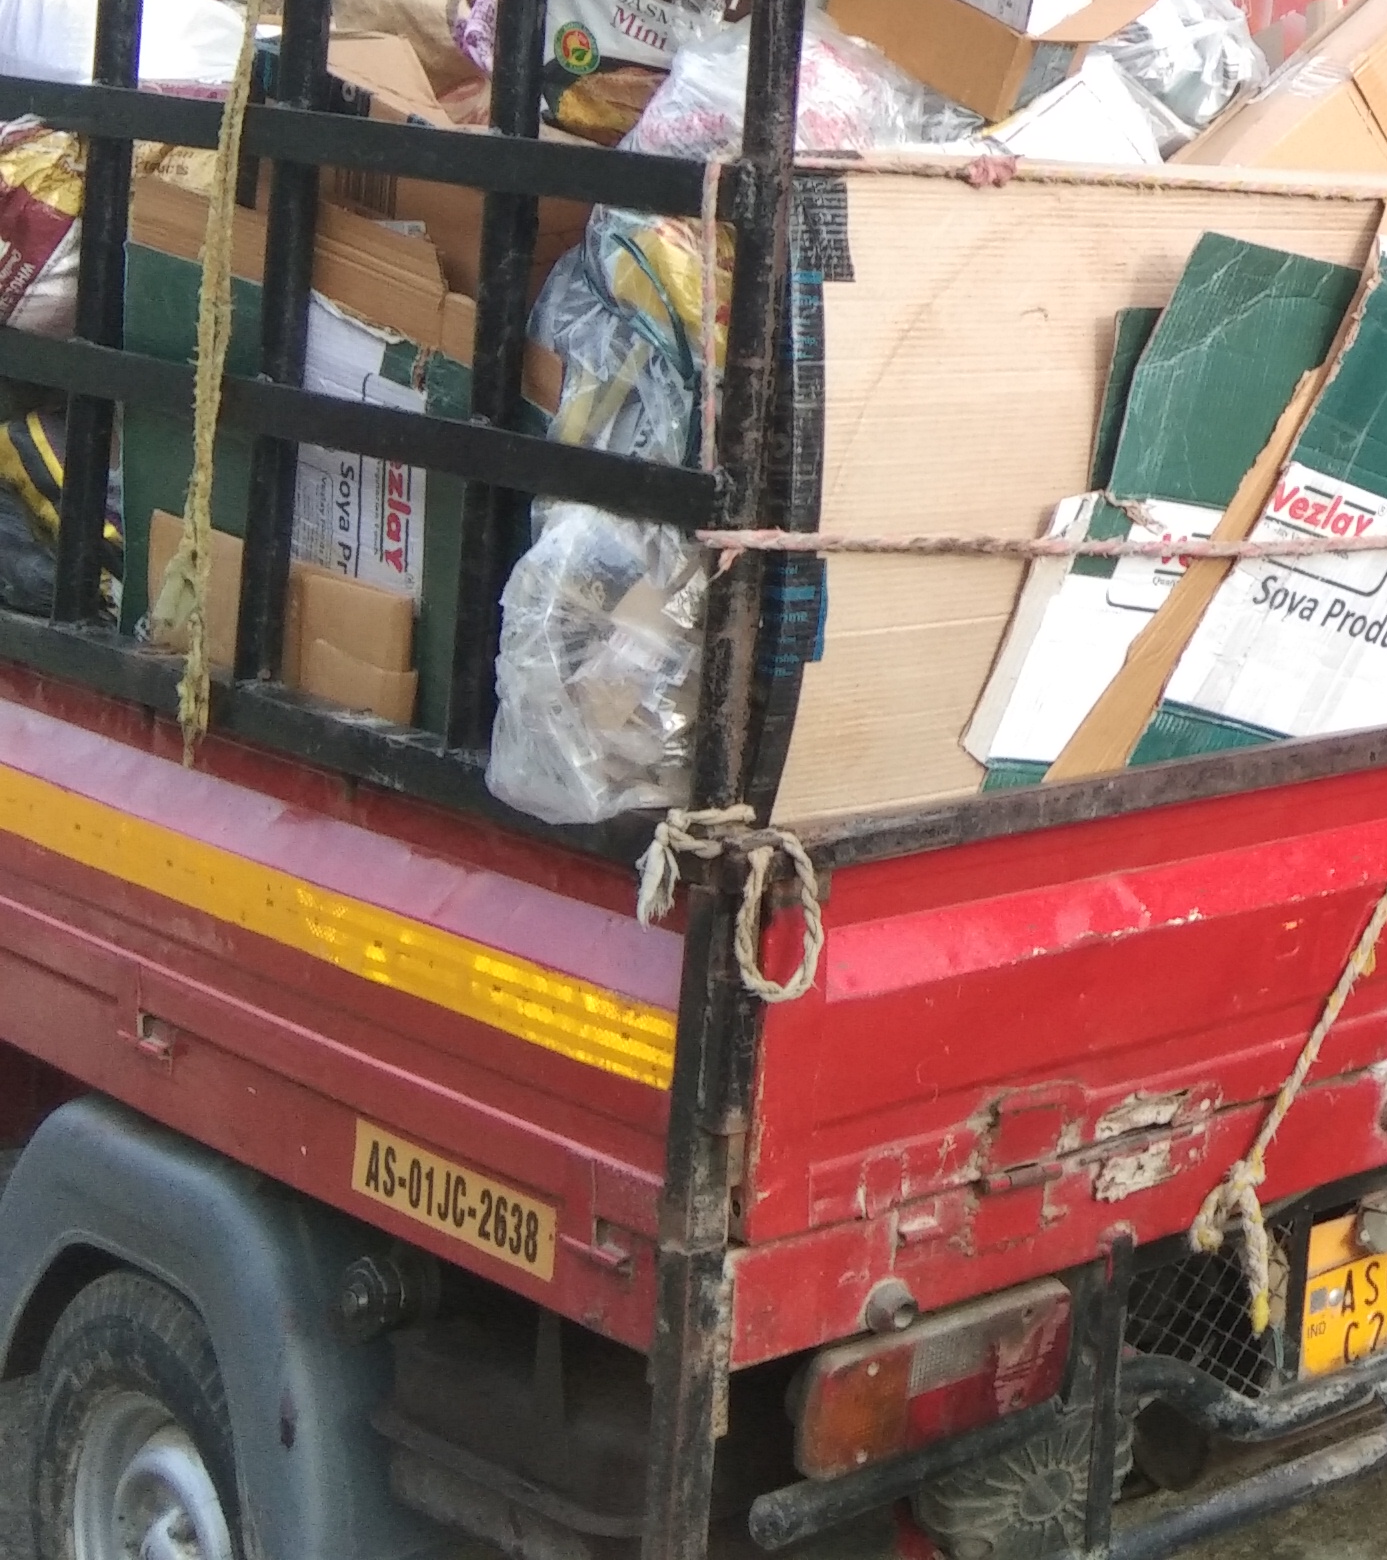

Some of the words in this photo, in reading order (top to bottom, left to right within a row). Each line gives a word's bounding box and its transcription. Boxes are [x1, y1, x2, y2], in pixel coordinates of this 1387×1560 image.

[609, 6, 670, 52] Mini
[336, 461, 355, 532] Soya
[1272, 481, 1374, 537] Vezlay
[365, 1140, 540, 1264] AS-01JC-2638
[1306, 1321, 1327, 1339] IND
